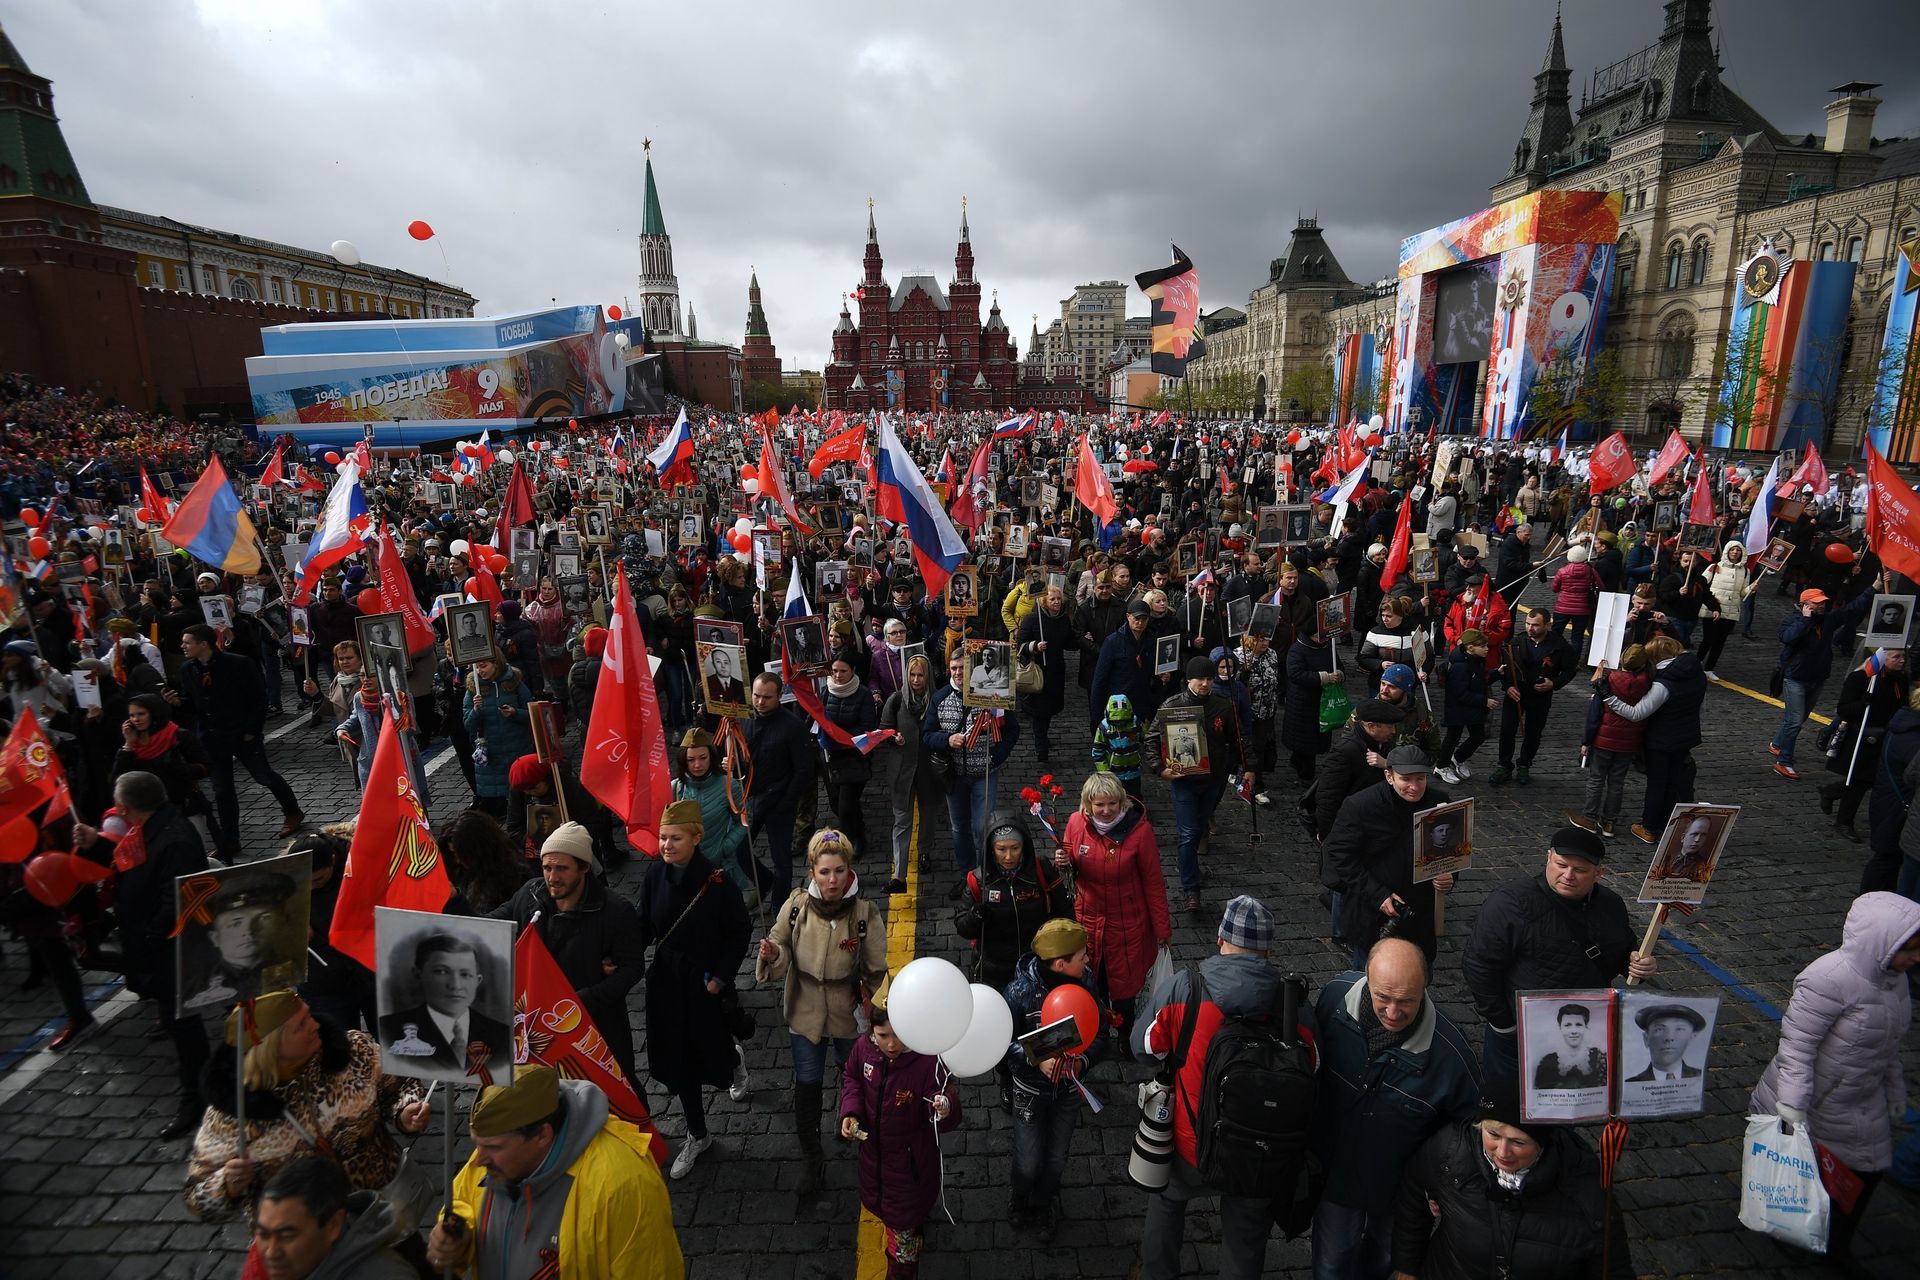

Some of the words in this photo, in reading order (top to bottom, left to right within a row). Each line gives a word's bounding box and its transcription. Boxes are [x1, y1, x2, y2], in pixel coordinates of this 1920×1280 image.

[1482, 207, 1529, 245] ПОБЕДА!
[500, 320, 534, 342] ПОБЕДА!
[477, 369, 499, 400] 9
[1497, 347, 1514, 392] 9
[314, 388, 342, 405] 1945
[330, 399, 346, 410] 2017
[350, 369, 449, 411] ПОБЕДА!
[477, 400, 504, 415] МАЯ
[595, 728, 629, 763] 79
[541, 998, 582, 1033] 9
